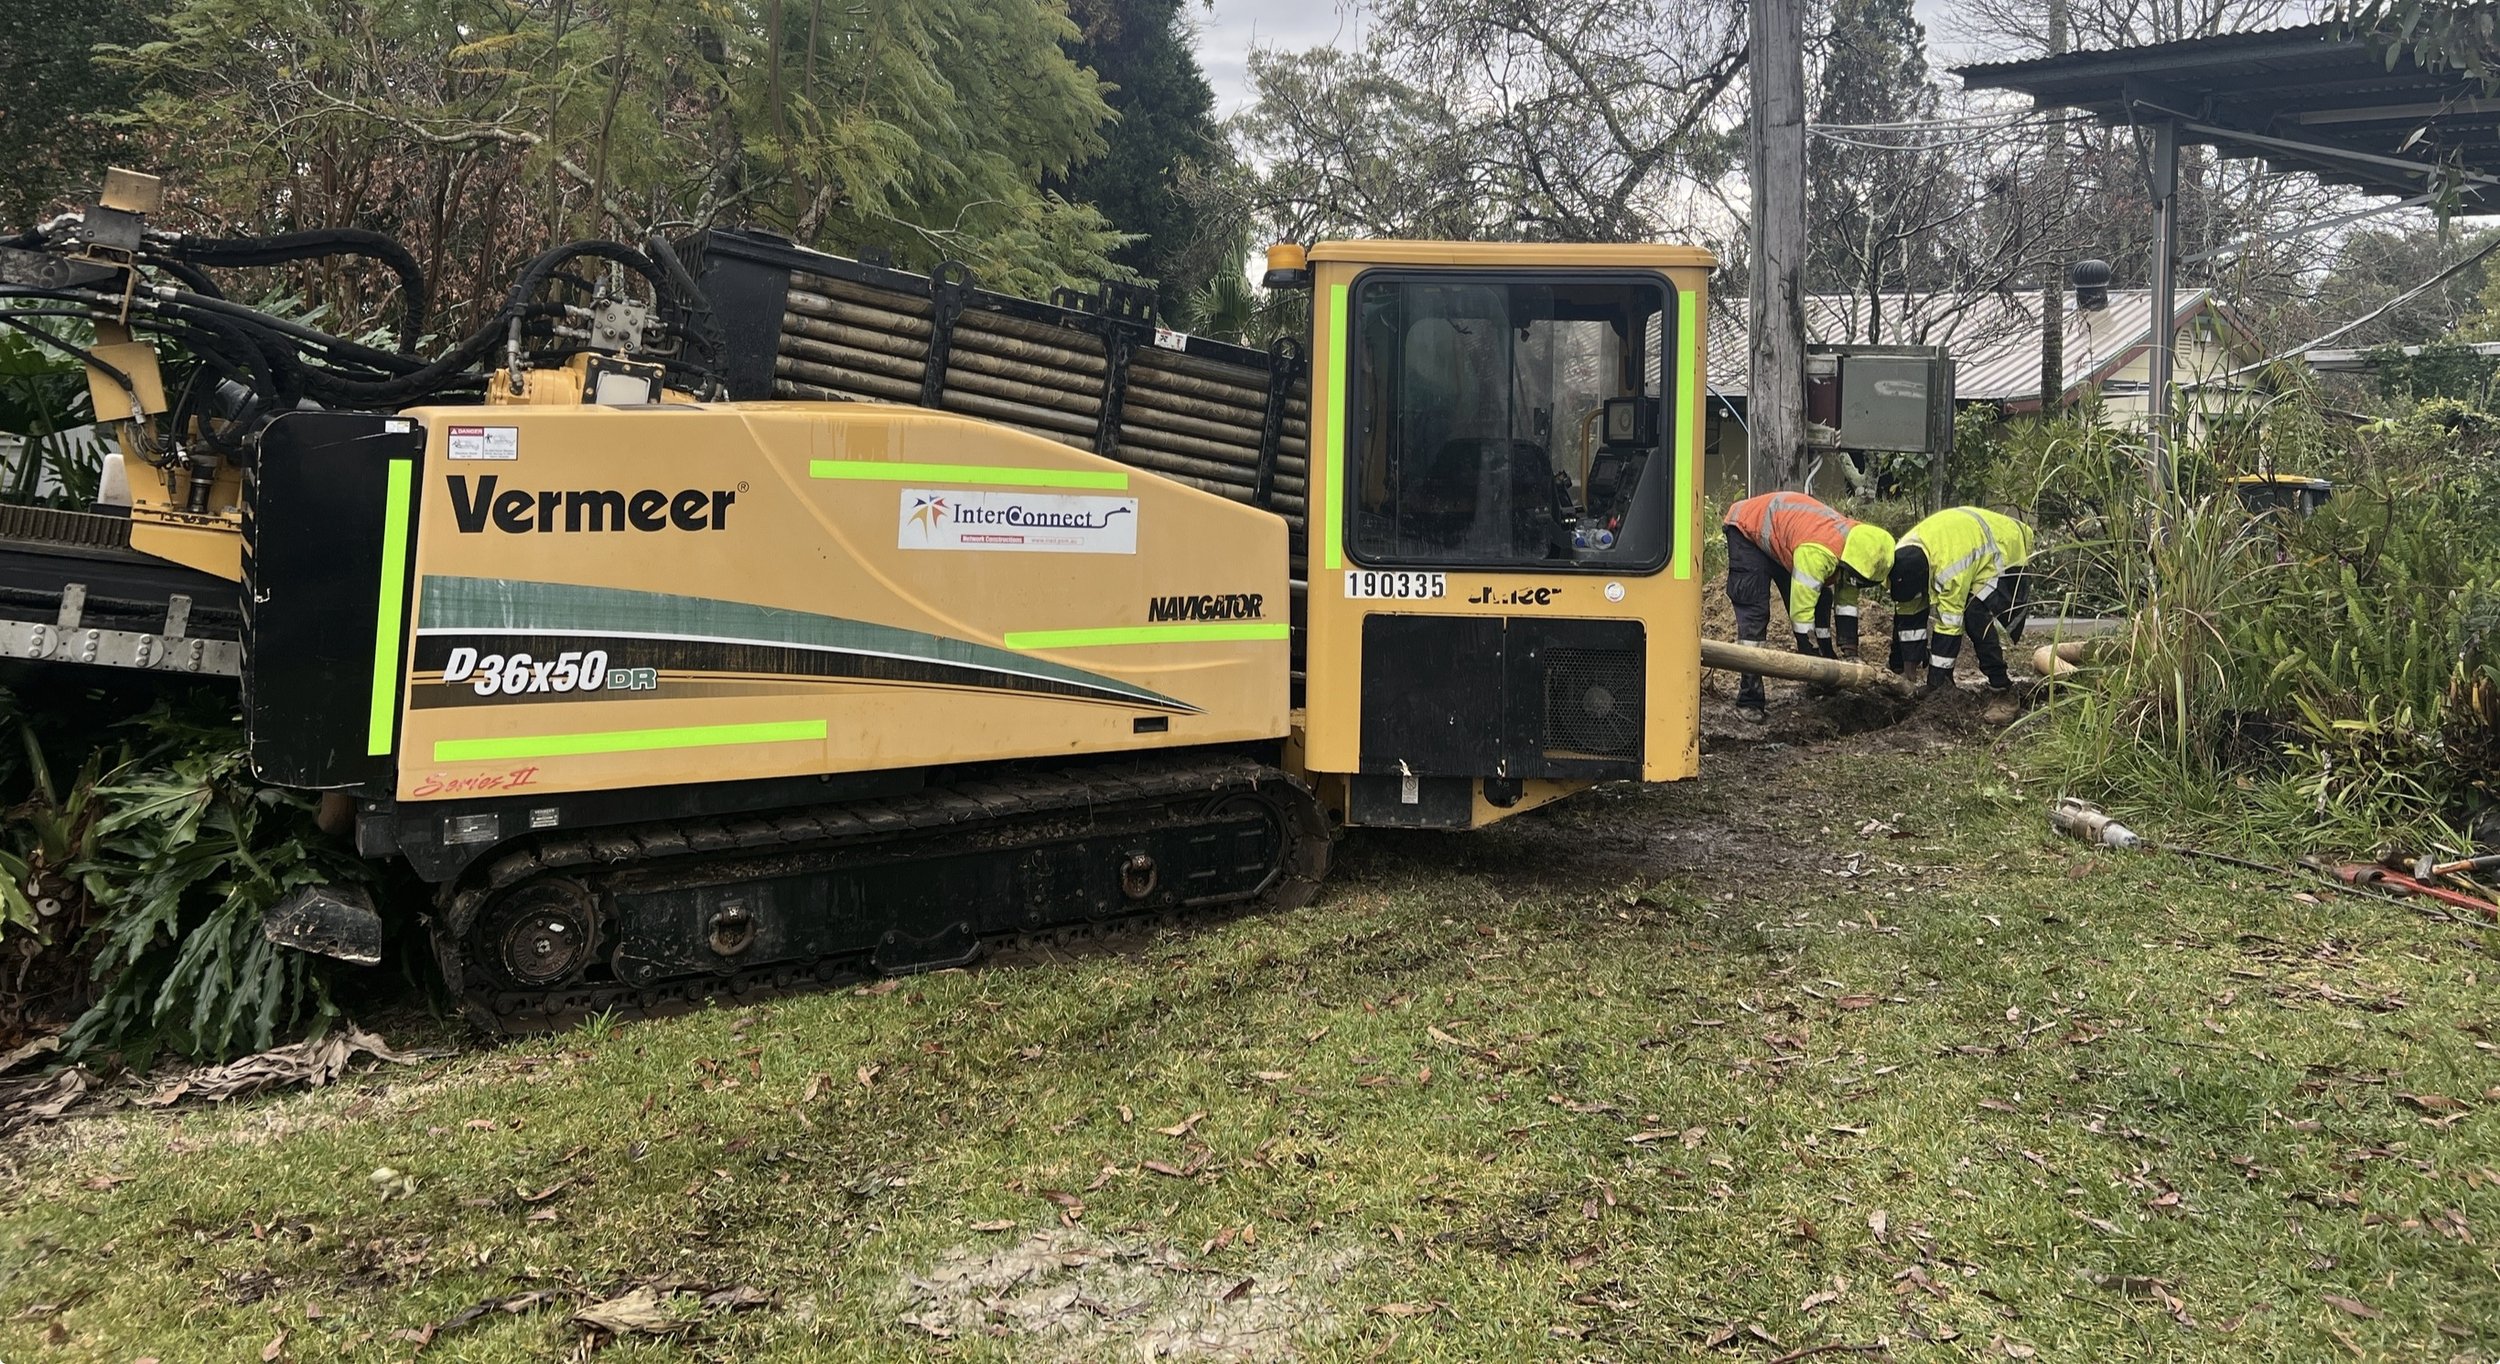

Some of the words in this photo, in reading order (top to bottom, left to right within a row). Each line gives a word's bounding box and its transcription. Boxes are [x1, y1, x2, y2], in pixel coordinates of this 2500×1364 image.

[953, 503, 1093, 528] InterConnect
[1349, 572, 1444, 598] 190335
[1148, 594, 1264, 622] NAVIGATOR
[413, 772, 504, 797] Series
